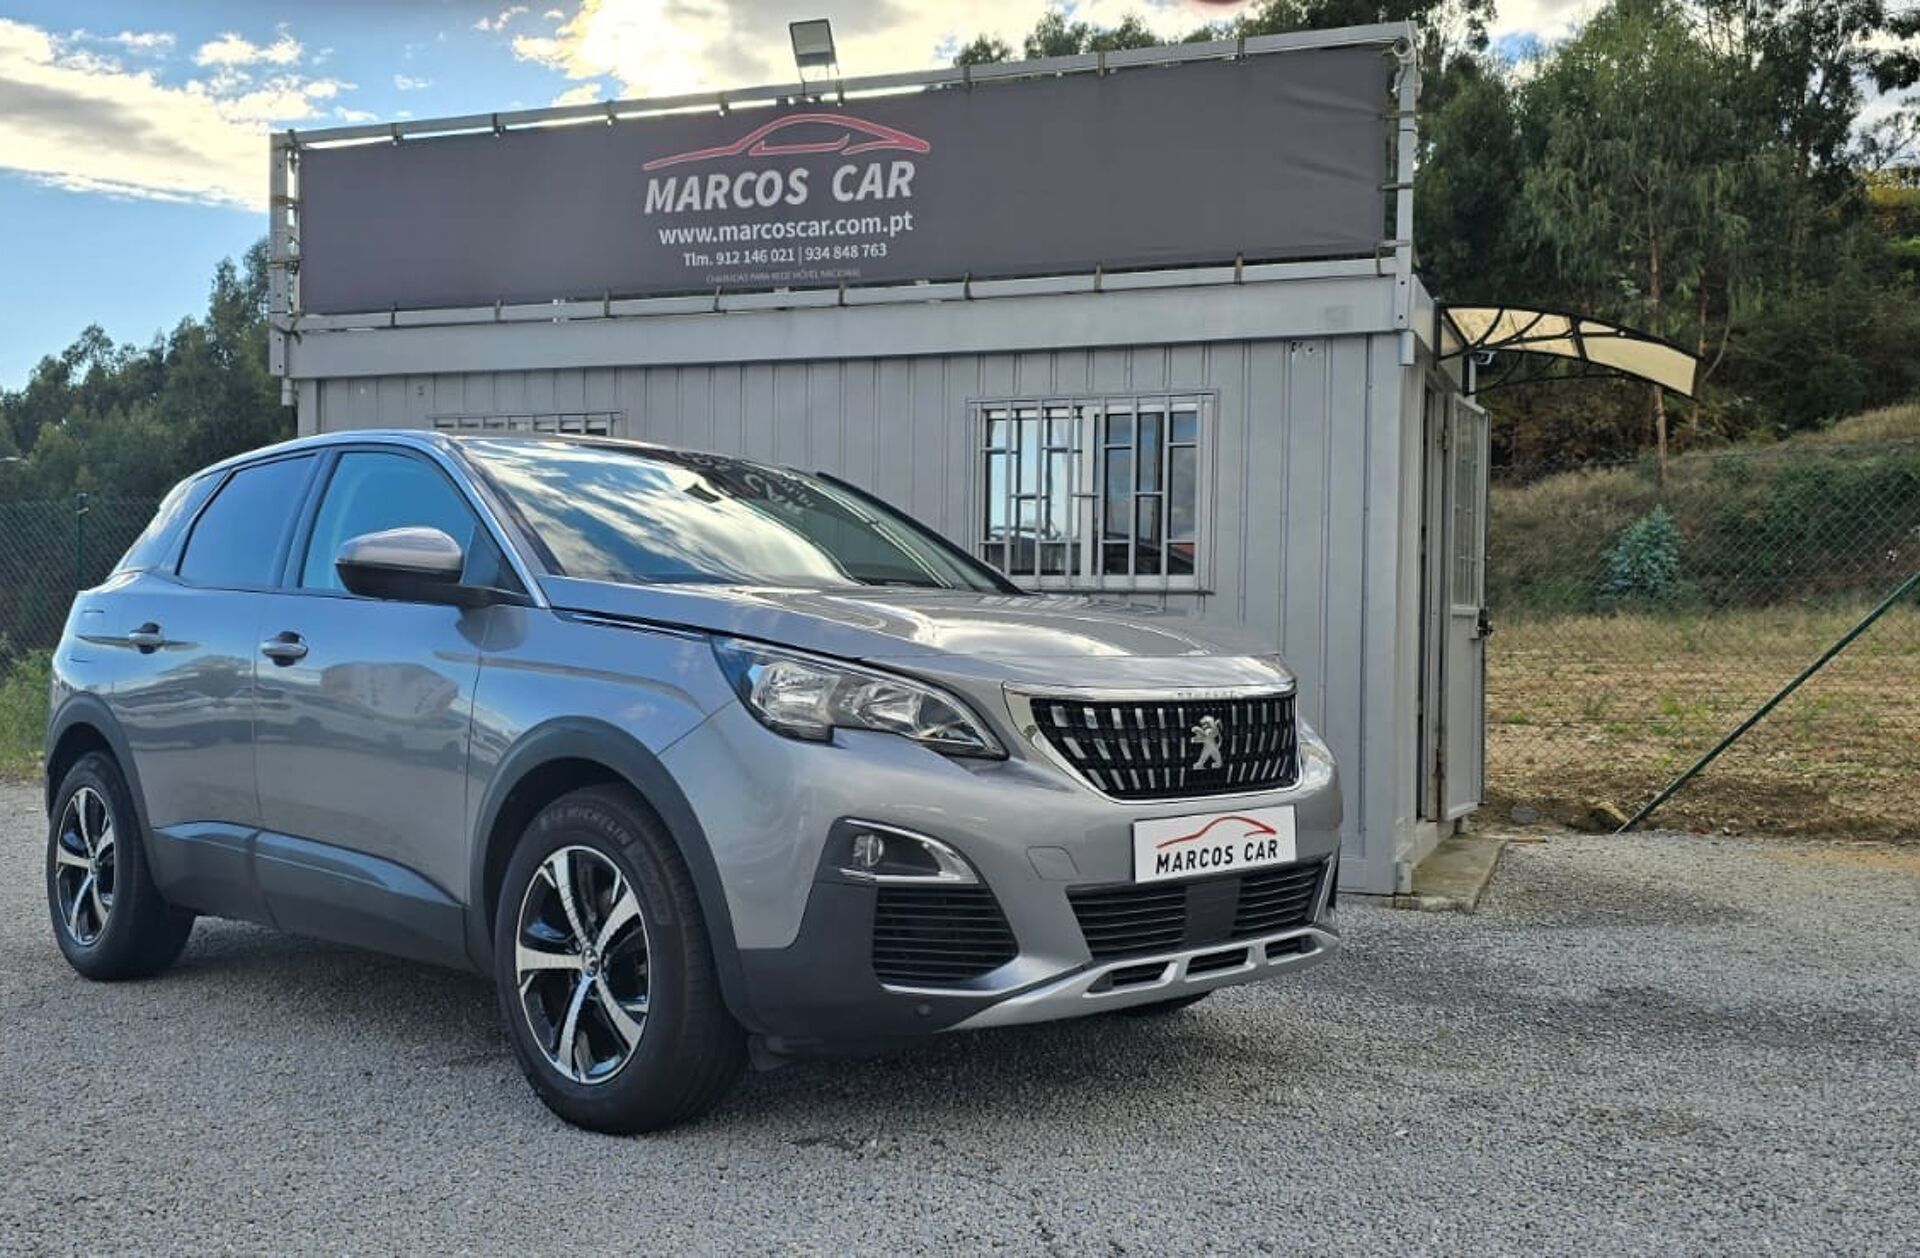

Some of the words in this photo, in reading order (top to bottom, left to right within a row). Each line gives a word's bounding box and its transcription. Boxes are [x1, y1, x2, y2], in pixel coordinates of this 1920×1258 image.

[644, 167, 809, 214] MARCOS
[832, 160, 916, 202] CAR
[659, 210, 914, 245] www.marcoscar.com.pt
[683, 251, 714, 267] Tlm.
[715, 250, 741, 265] 912
[743, 248, 769, 264] 146
[770, 247, 796, 262] 021
[804, 245, 830, 261] 934
[832, 243, 859, 260] 848
[860, 242, 888, 258] 763
[1155, 845, 1234, 875] MARCOS
[1243, 839, 1278, 861] CAR
